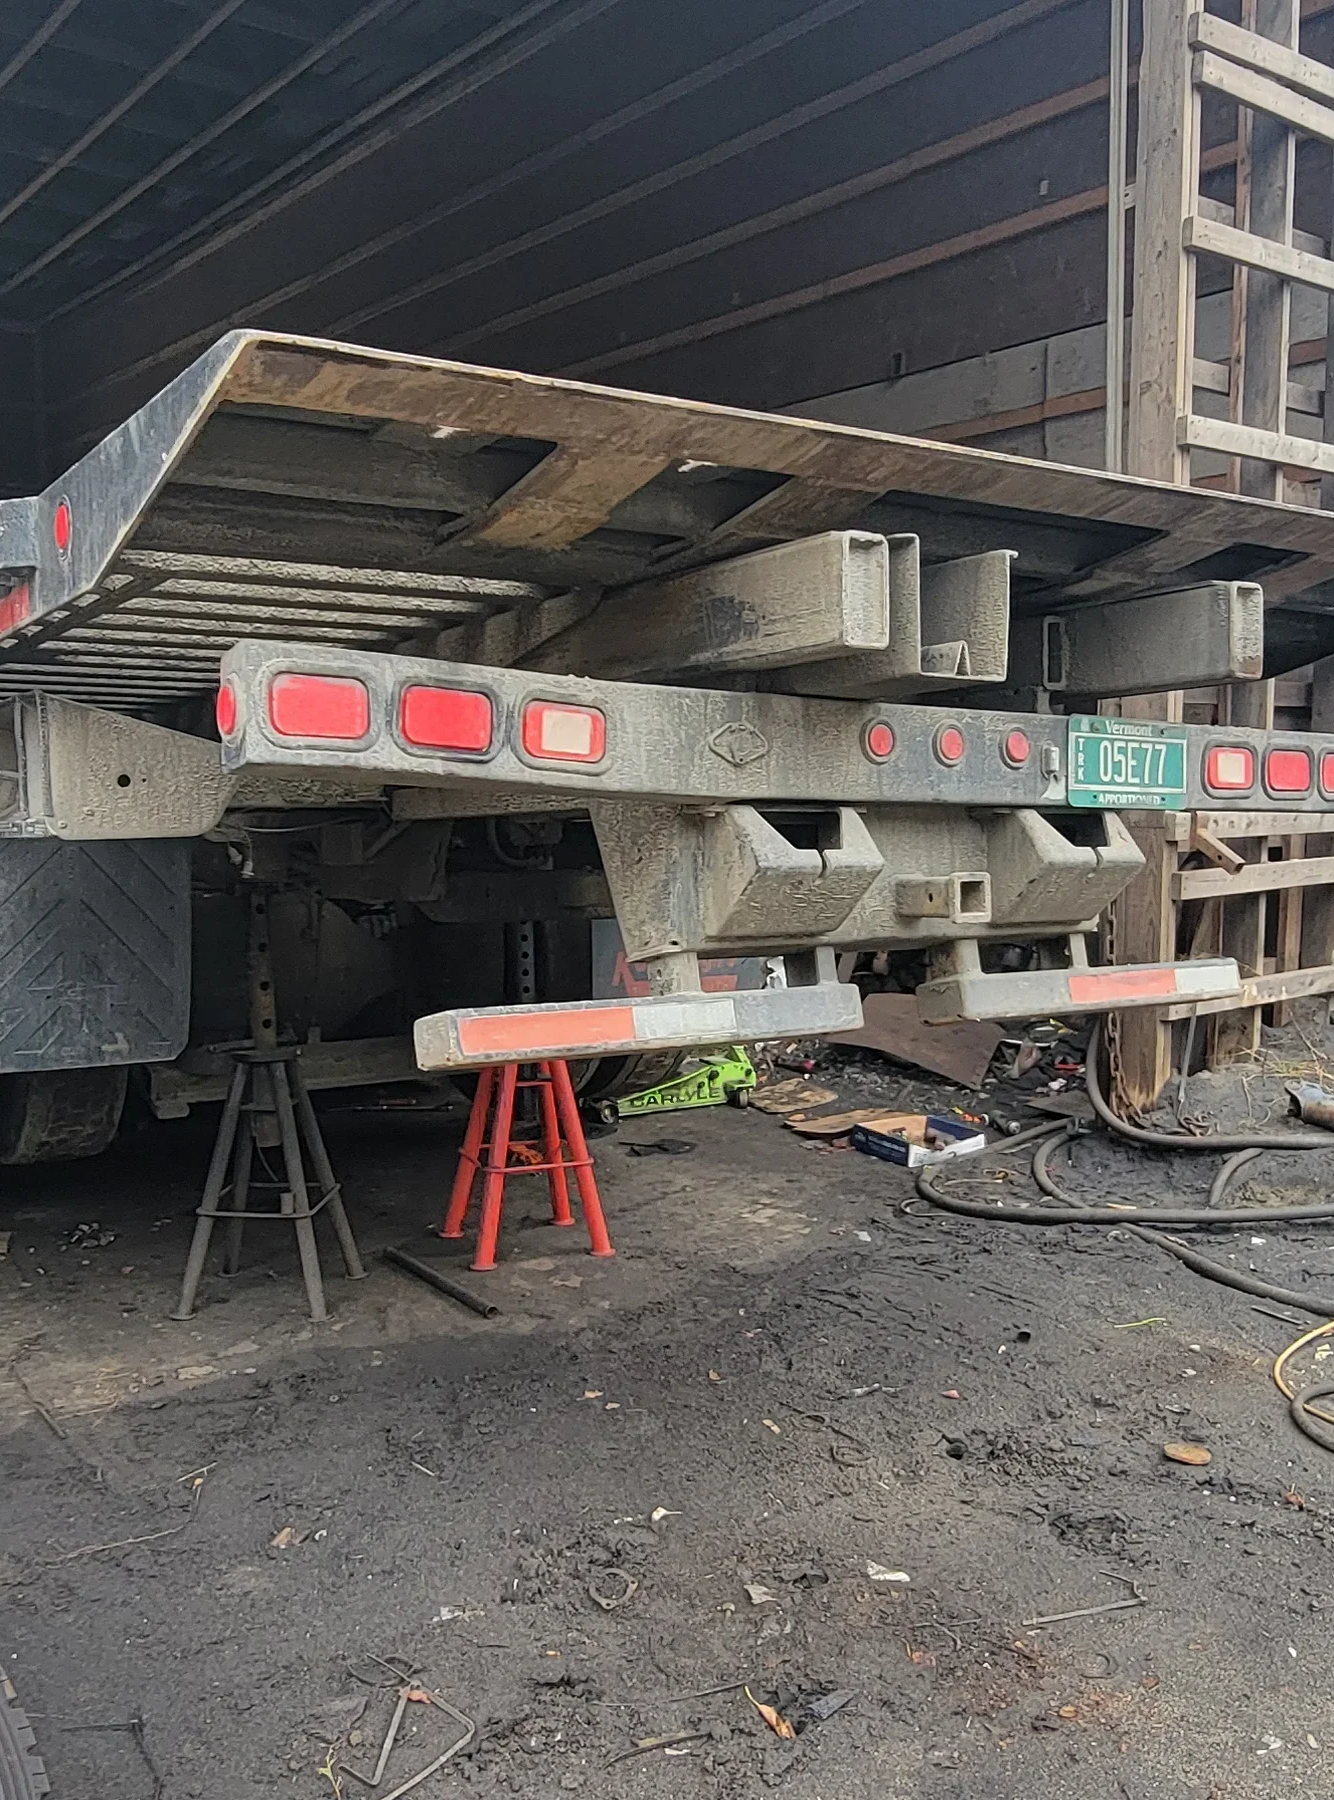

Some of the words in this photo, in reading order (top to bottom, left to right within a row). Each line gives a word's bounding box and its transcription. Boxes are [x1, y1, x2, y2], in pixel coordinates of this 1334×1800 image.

[1105, 720, 1153, 736] Vermont
[1077, 738, 1085, 781] TRK
[1099, 739, 1167, 785] 05E77
